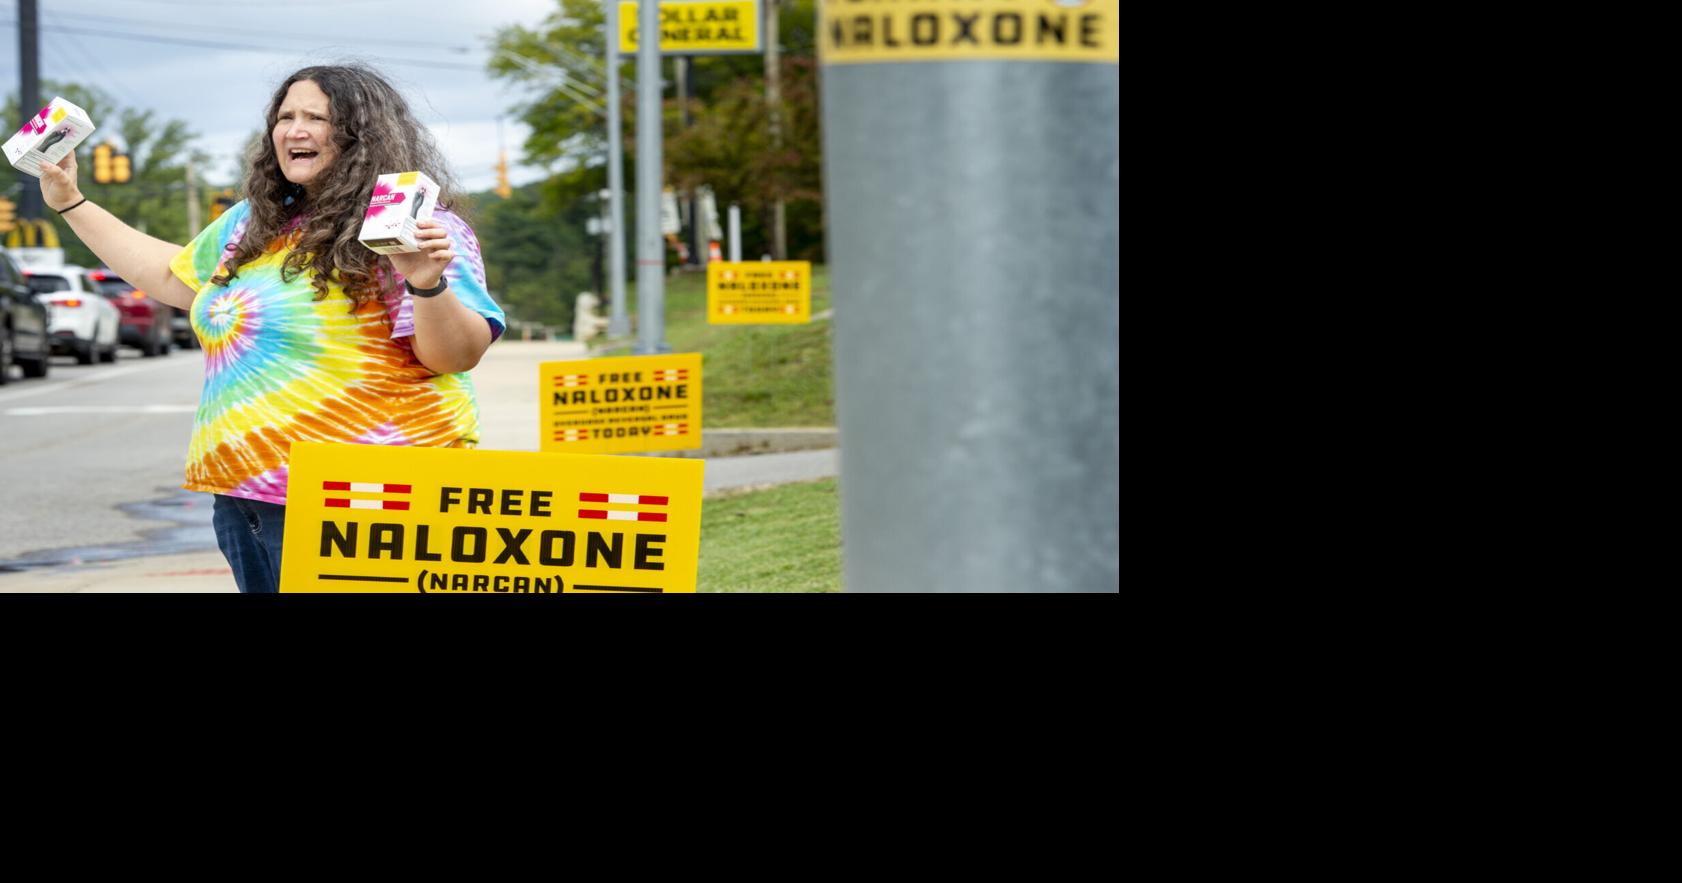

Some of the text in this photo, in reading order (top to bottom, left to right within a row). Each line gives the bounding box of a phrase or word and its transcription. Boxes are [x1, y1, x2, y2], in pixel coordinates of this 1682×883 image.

[598, 371, 642, 384] FREE
[554, 384, 688, 406] NALOXONE
[592, 426, 651, 439] TODAY
[440, 486, 553, 517] FREE
[319, 520, 667, 571] NALOXONE
[417, 569, 564, 593] (NARCAN)
